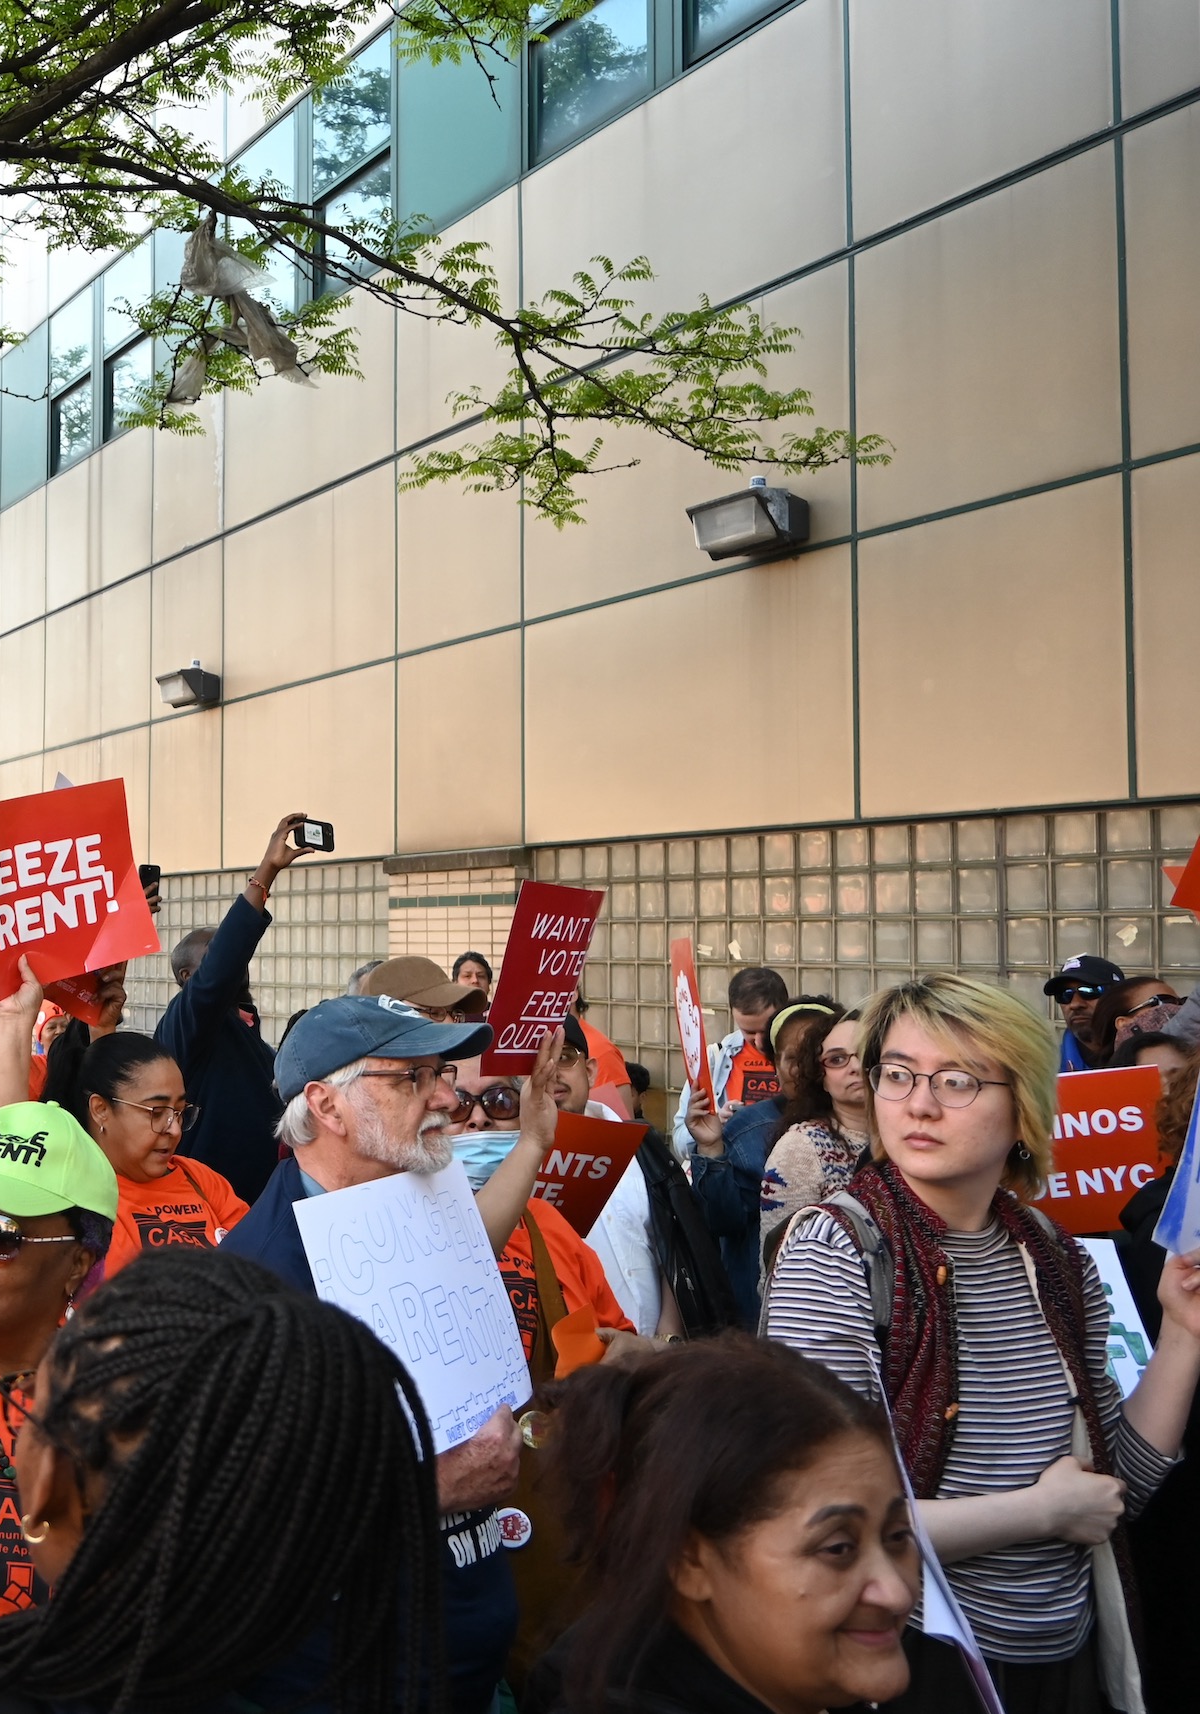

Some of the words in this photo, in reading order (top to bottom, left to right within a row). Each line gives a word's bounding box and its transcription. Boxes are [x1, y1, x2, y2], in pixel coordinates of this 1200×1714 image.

[531, 912, 591, 943] WANT
[747, 1079, 782, 1092] CAS
[538, 1149, 612, 1180] NTS
[1075, 1163, 1156, 1196] NYC
[154, 1203, 204, 1216] POWER!
[147, 1227, 208, 1250] CASA
[447, 1529, 477, 1569] ON
